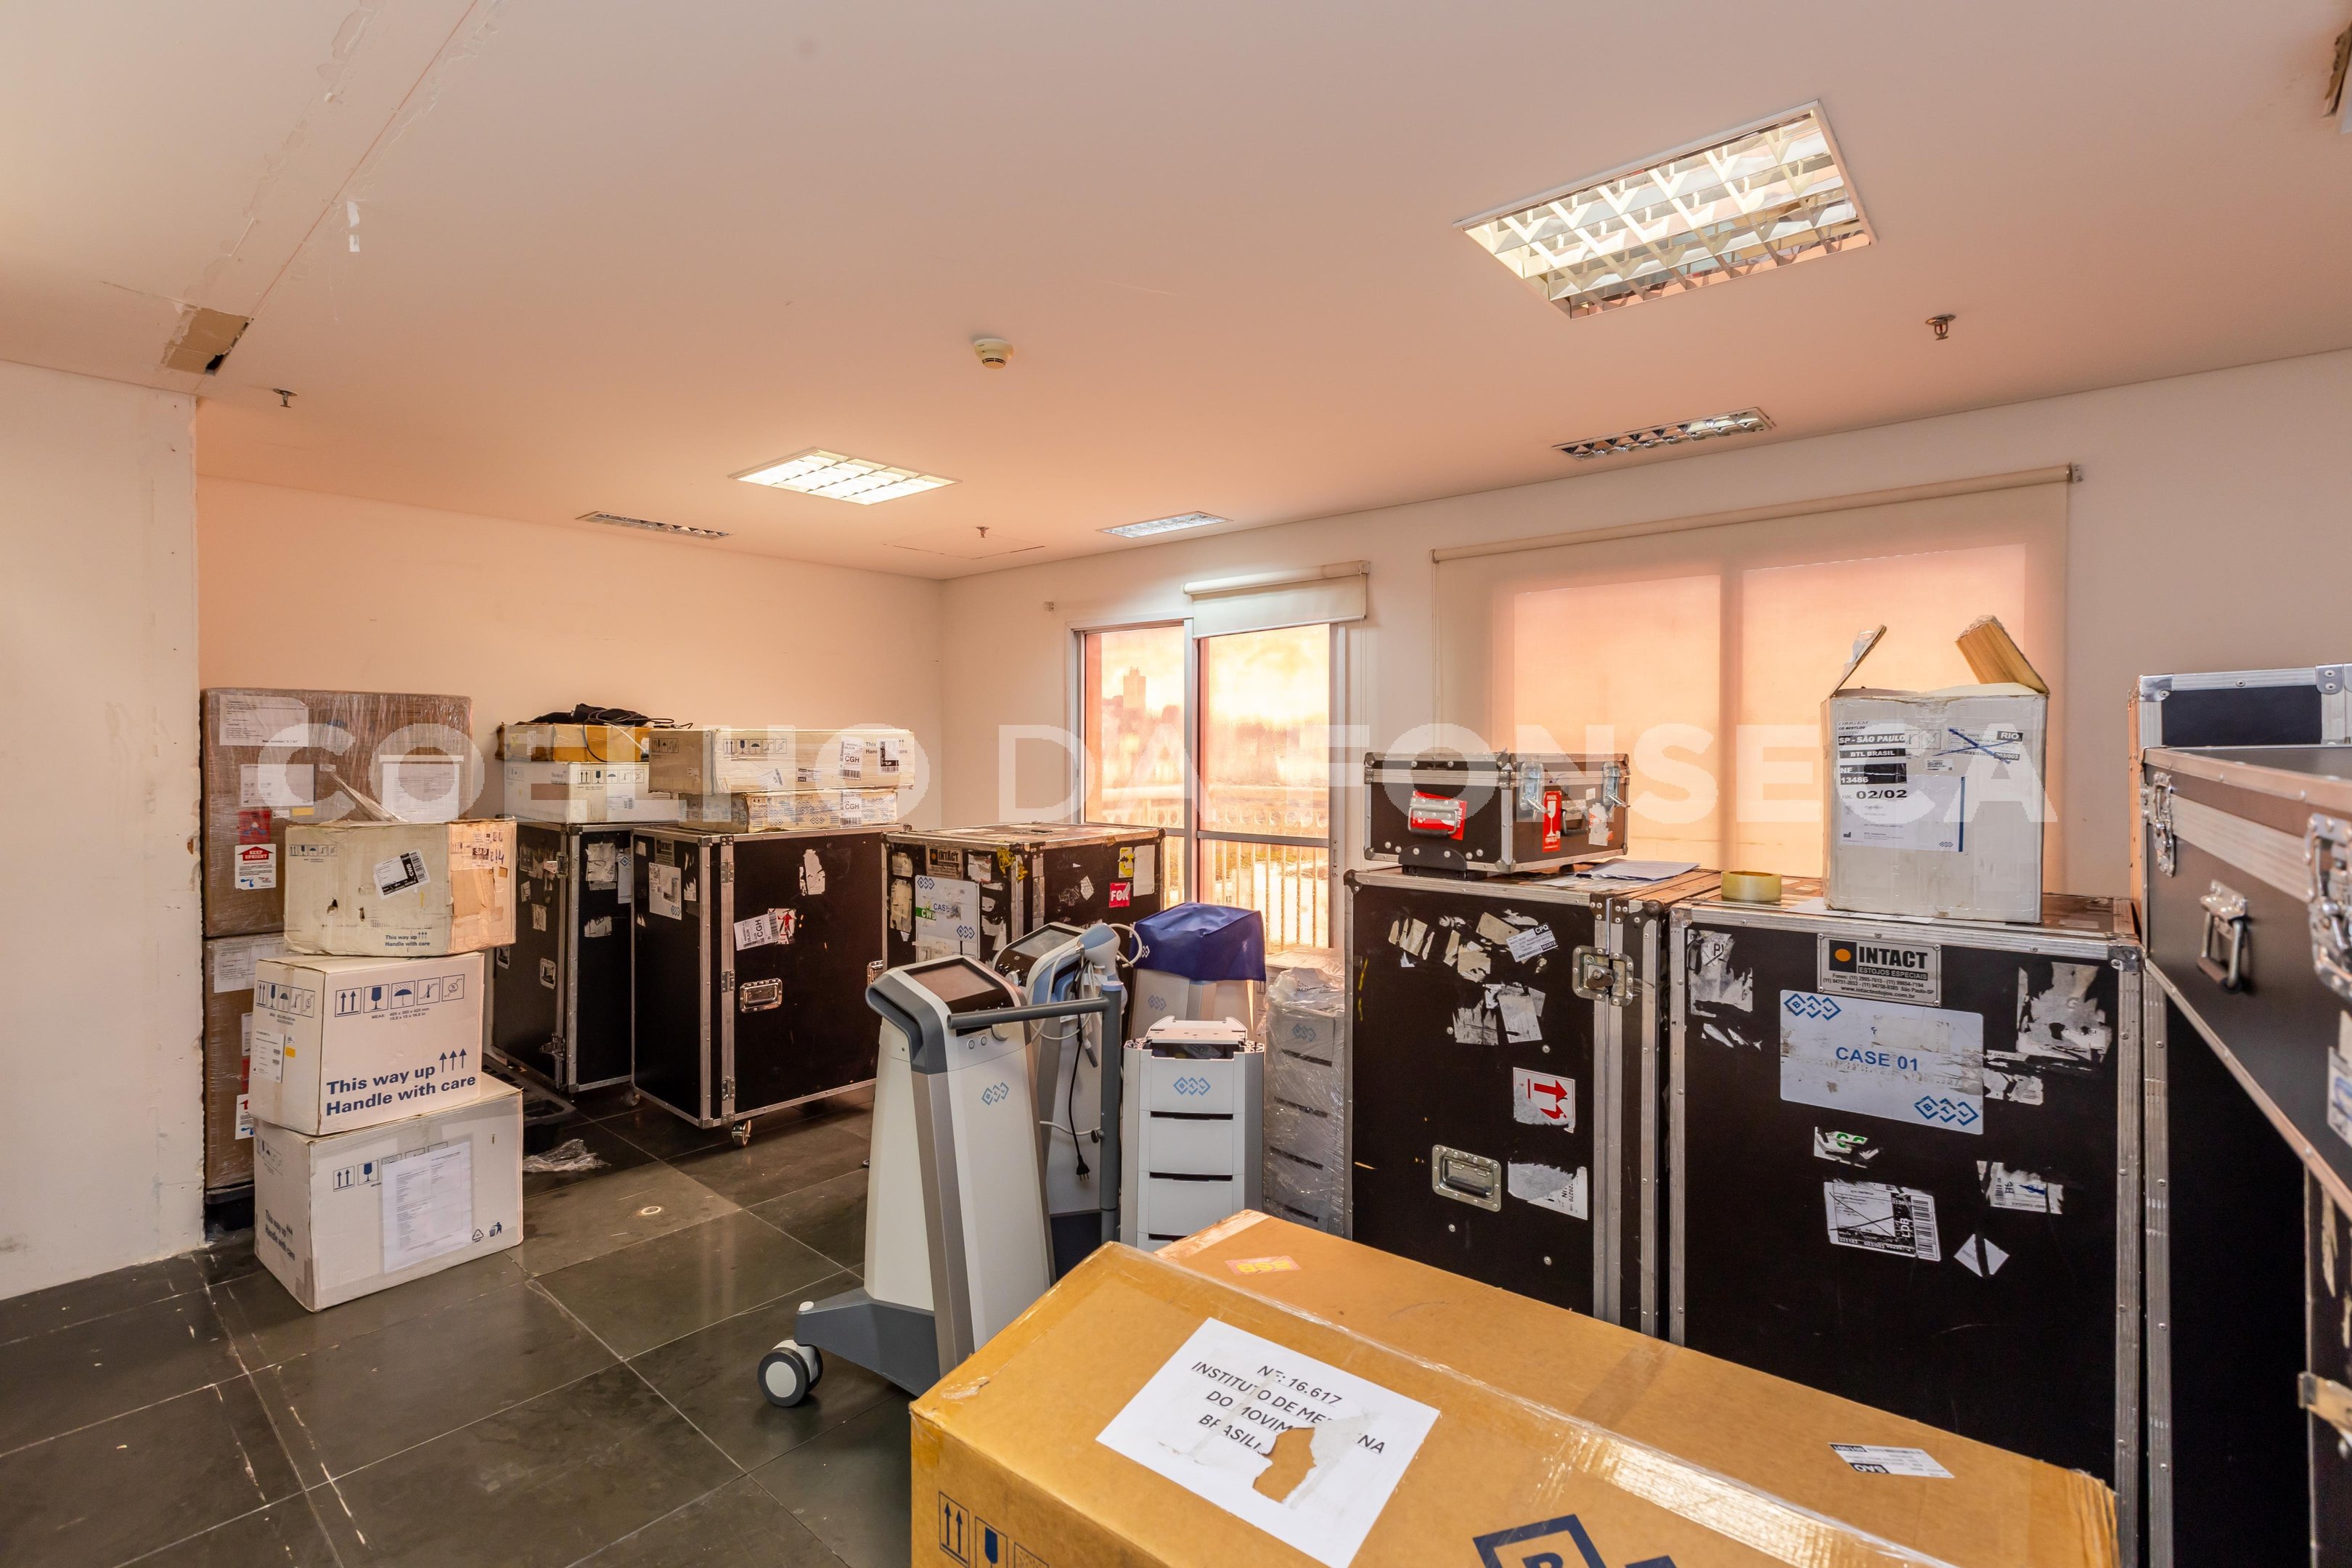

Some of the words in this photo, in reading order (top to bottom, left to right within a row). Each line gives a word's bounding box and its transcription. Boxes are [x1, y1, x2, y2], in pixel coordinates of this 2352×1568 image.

[1856, 790, 1908, 799] 02/02
[938, 851, 959, 862] INTACT
[755, 919, 764, 937] CGH
[1535, 924, 1549, 934] CPQ
[1859, 947, 1928, 969] INTACT
[1858, 967, 1890, 976] ESTOJOS
[1892, 970, 1928, 981] ESPECIAIS
[1841, 986, 1915, 999] www.intactestojos.com.br
[1836, 1047, 1890, 1067] CASE
[1898, 1055, 1918, 1071] 01
[327, 1078, 367, 1095] This
[373, 1071, 409, 1087] way
[415, 1066, 436, 1079] up
[327, 1093, 393, 1116] Handle
[398, 1083, 436, 1101] with
[441, 1076, 476, 1092] care
[1900, 1218, 1911, 1238] LDB
[1206, 1391, 1233, 1408] DO
[1289, 1378, 1342, 1404] 16.617
[1272, 1395, 1299, 1413] DE
[1855, 1463, 1887, 1473] SAO
